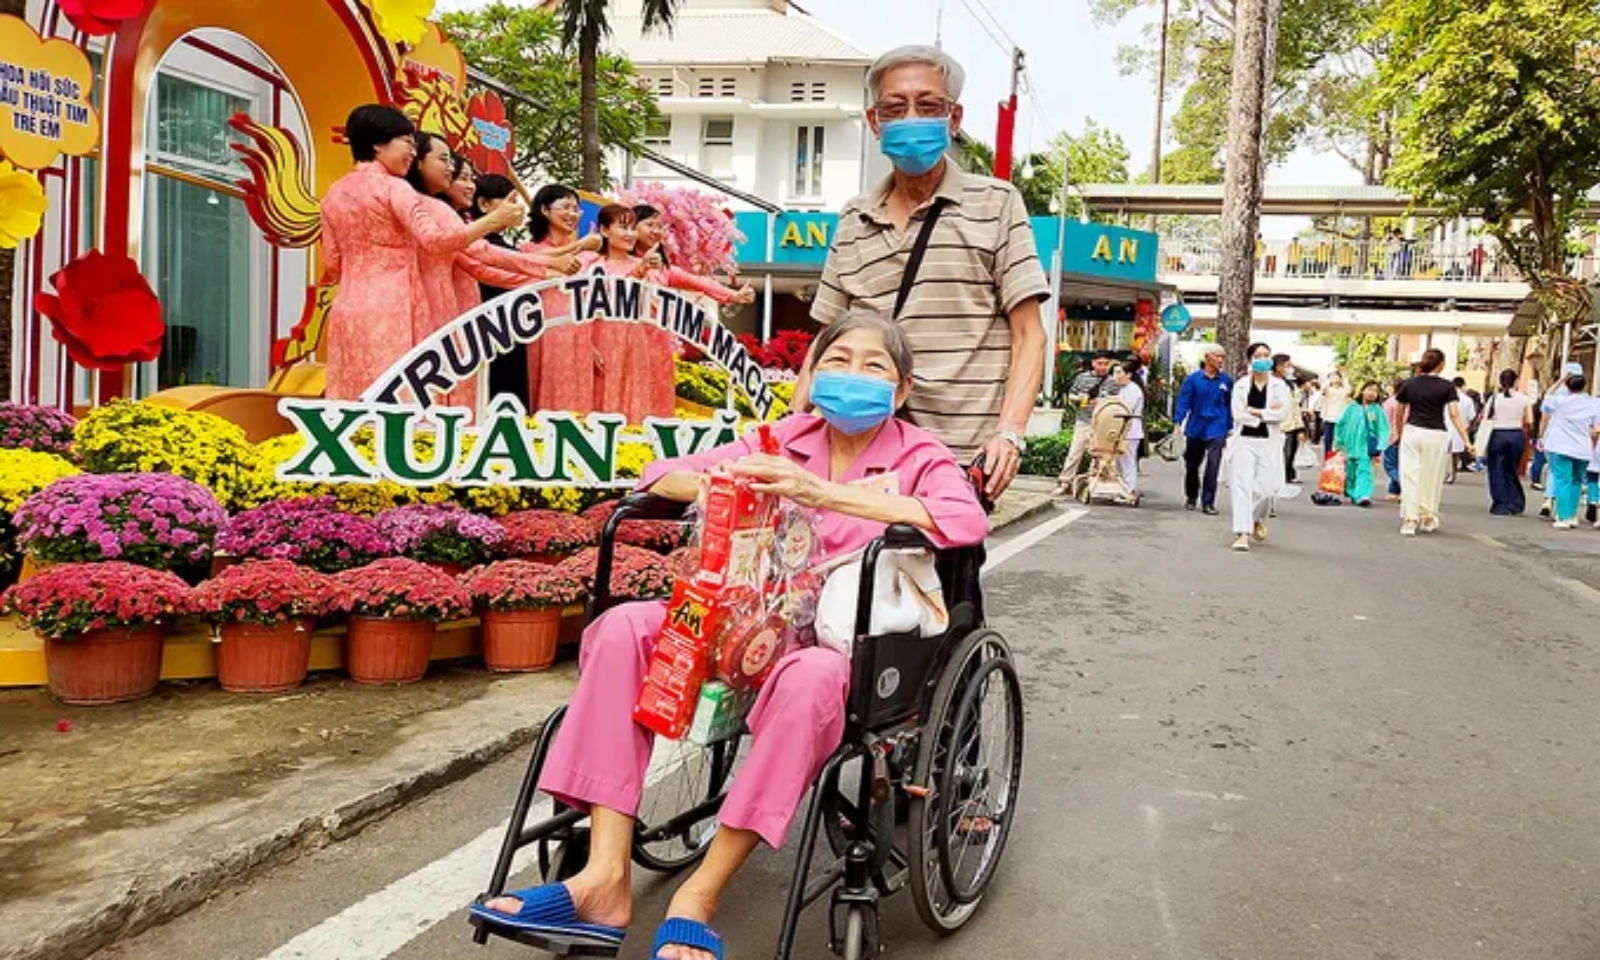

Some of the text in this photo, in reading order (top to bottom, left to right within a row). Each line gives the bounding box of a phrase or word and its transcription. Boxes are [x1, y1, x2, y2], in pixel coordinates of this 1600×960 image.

[30, 69, 51, 93] HỒI
[54, 77, 80, 100] SỨC
[23, 92, 62, 119] THUẬT
[66, 103, 89, 125] TIM
[40, 119, 61, 139] EM
[780, 221, 830, 249] AN
[1091, 234, 1140, 265] AN
[376, 266, 774, 420] TRUNG TÂM TIM MẠCH
[284, 400, 740, 482] XUÂN VĂ
